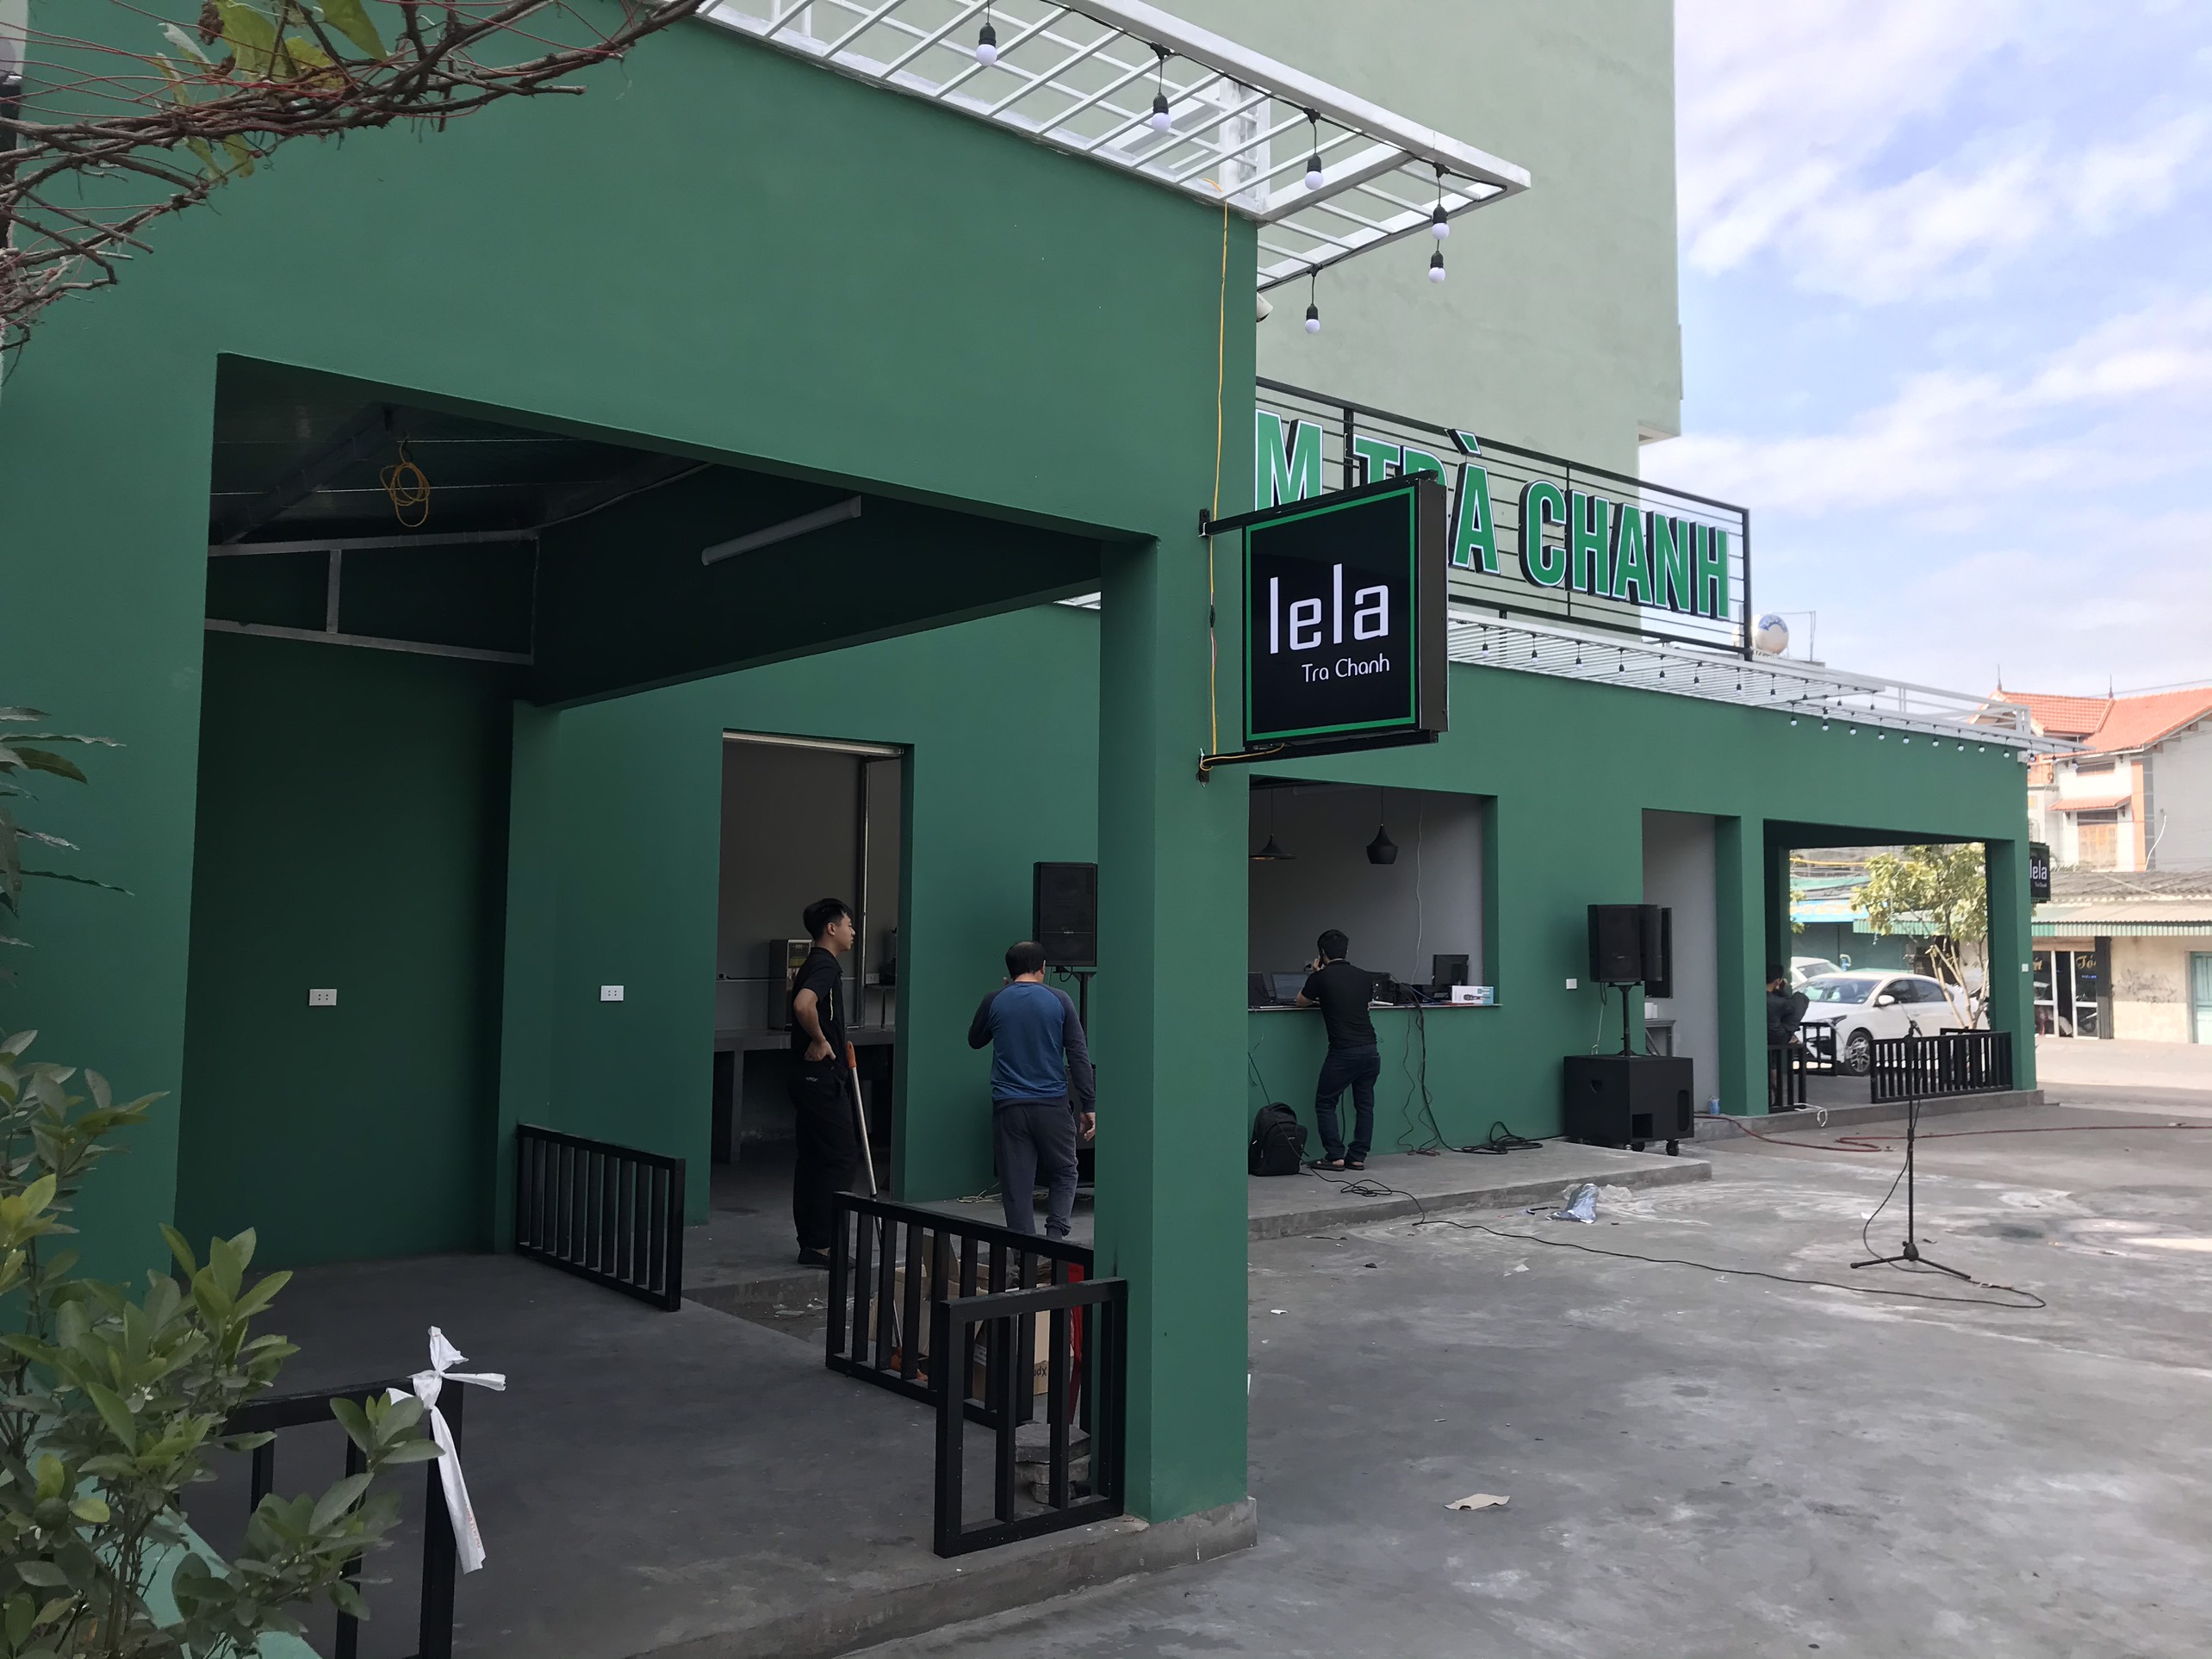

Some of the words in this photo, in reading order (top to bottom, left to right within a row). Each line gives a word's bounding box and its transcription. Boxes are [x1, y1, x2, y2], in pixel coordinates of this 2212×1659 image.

[1519, 479, 1730, 619] CHANH
[1270, 562, 1389, 655] lela
[1302, 662, 1329, 682] Tra
[1335, 652, 1390, 678] Chanh
[2029, 859, 2047, 879] lela
